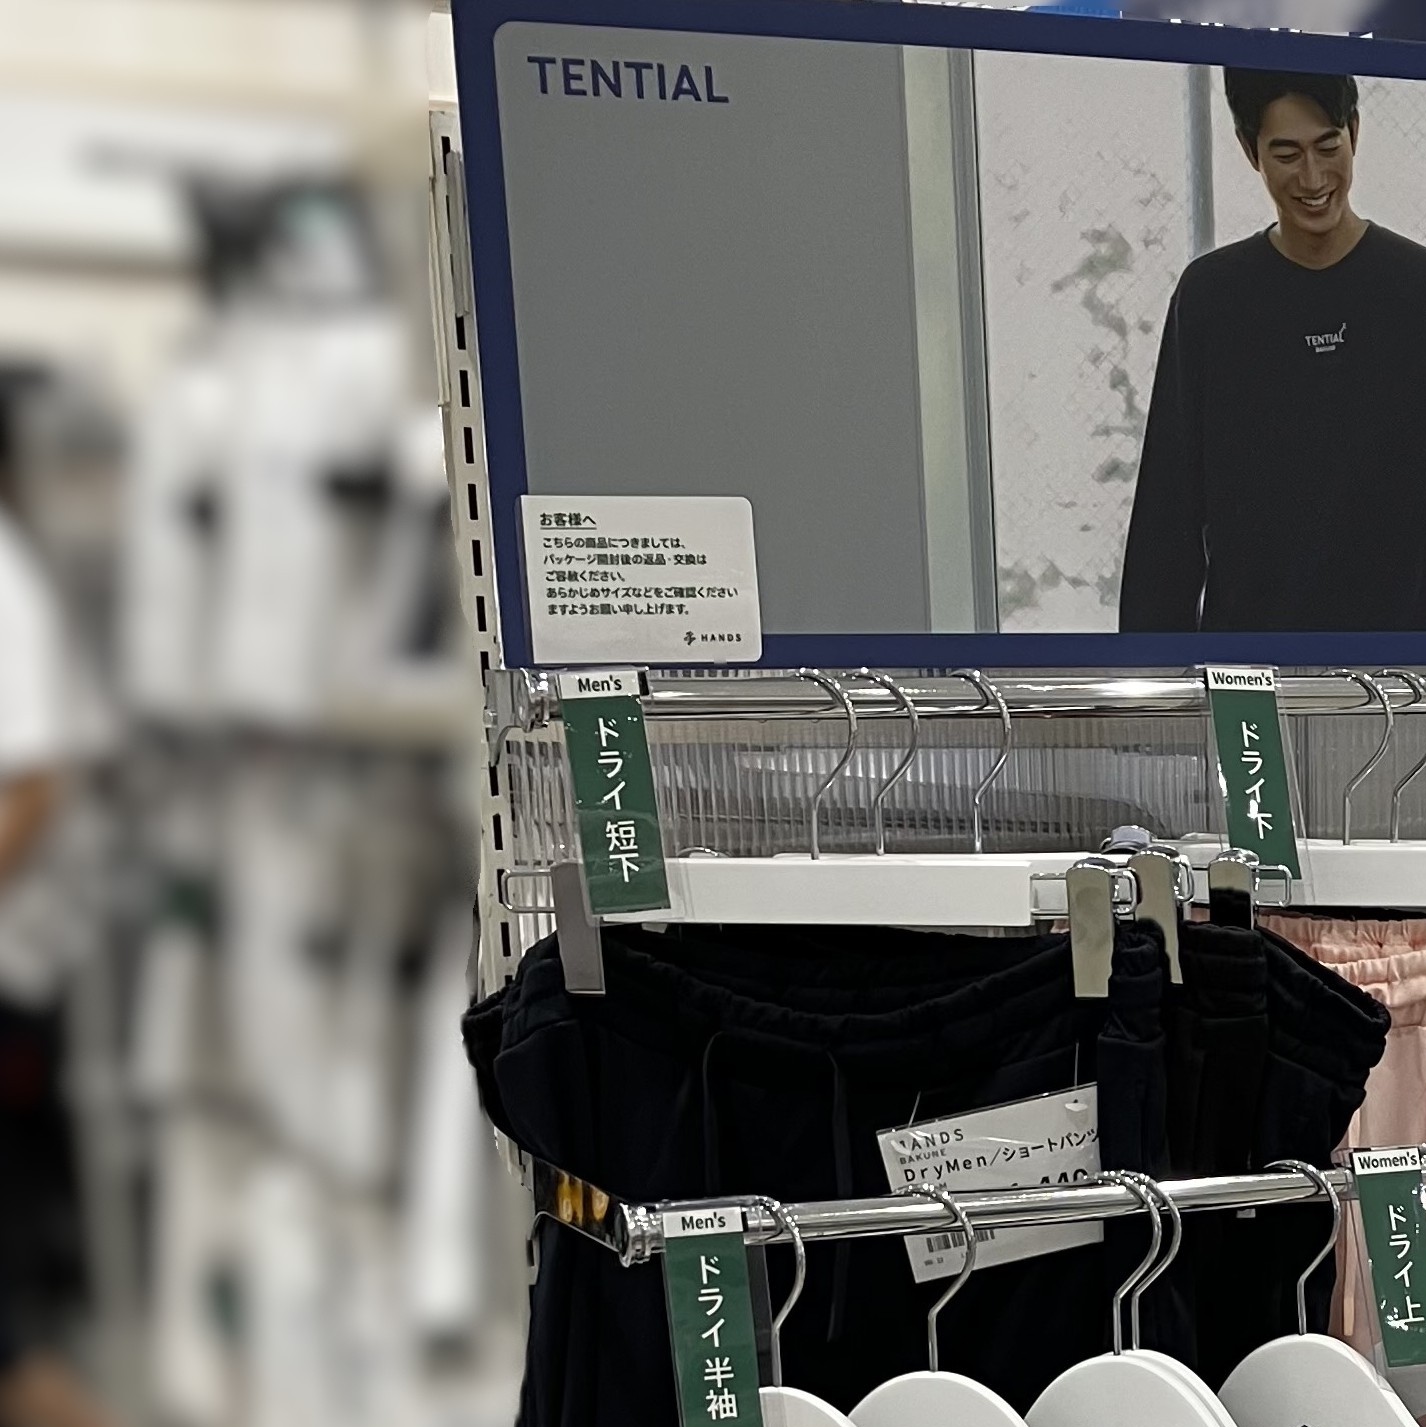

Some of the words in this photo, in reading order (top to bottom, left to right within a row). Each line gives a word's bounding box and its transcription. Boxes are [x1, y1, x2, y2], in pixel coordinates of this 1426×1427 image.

[527, 56, 730, 103] TENTIAL
[540, 512, 597, 527] お客様へ
[701, 633, 742, 642] HANDS
[577, 675, 622, 693] Men's
[1212, 671, 1273, 687] Women's
[1358, 1153, 1418, 1171] Women's
[681, 1211, 727, 1231] Men's
